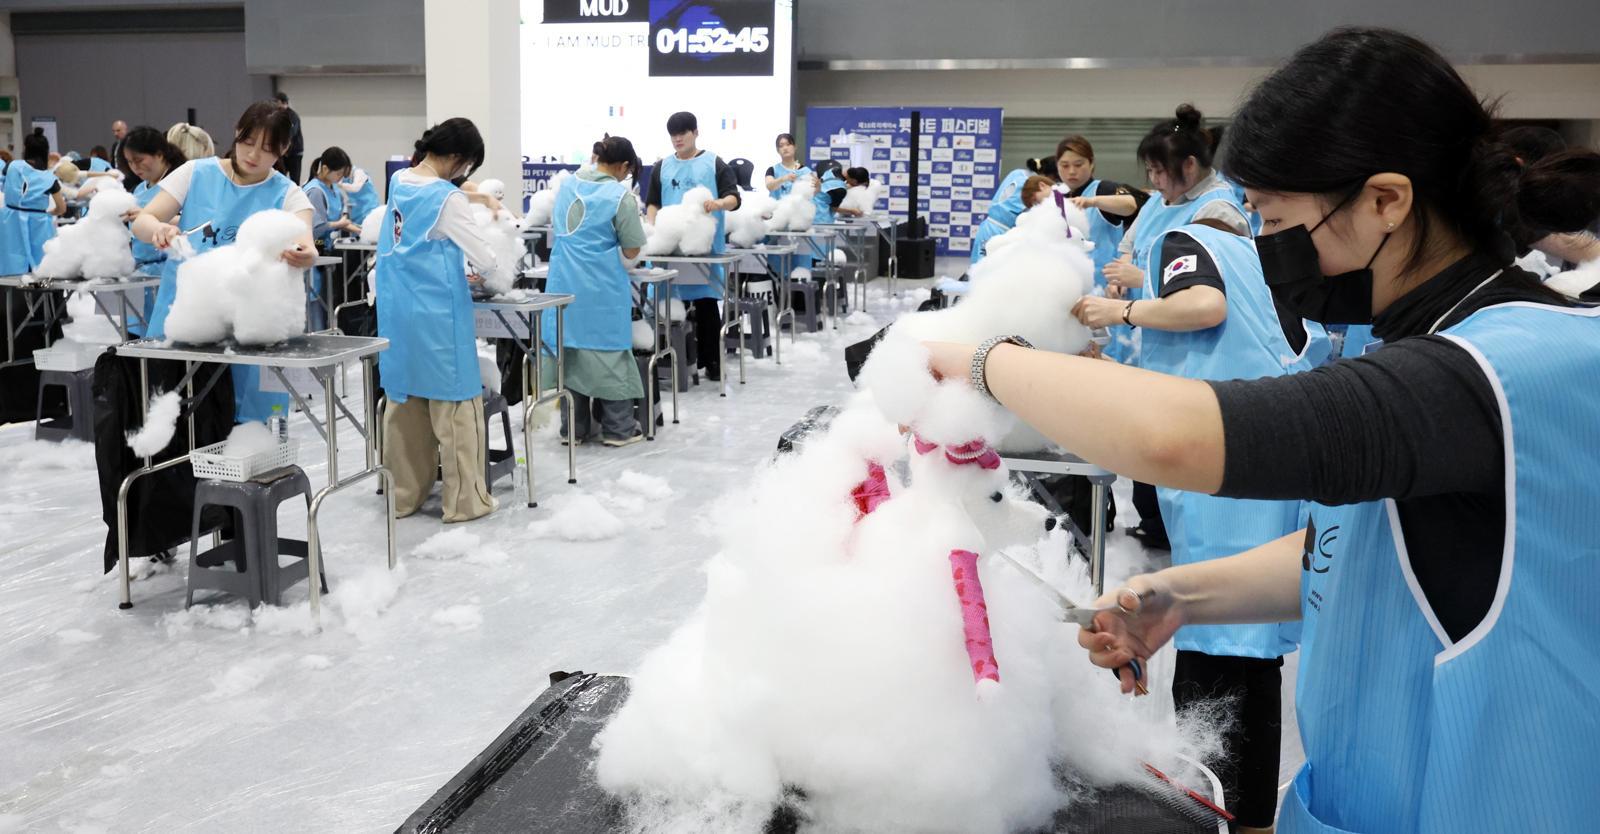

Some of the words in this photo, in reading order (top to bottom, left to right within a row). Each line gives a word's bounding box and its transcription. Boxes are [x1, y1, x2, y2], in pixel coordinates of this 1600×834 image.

[579, 0, 629, 17] MUD
[556, 36, 579, 48] AM
[584, 35, 622, 48] MUD
[656, 27, 769, 54] 01:52:45
[941, 118, 990, 134] 페스티벌
